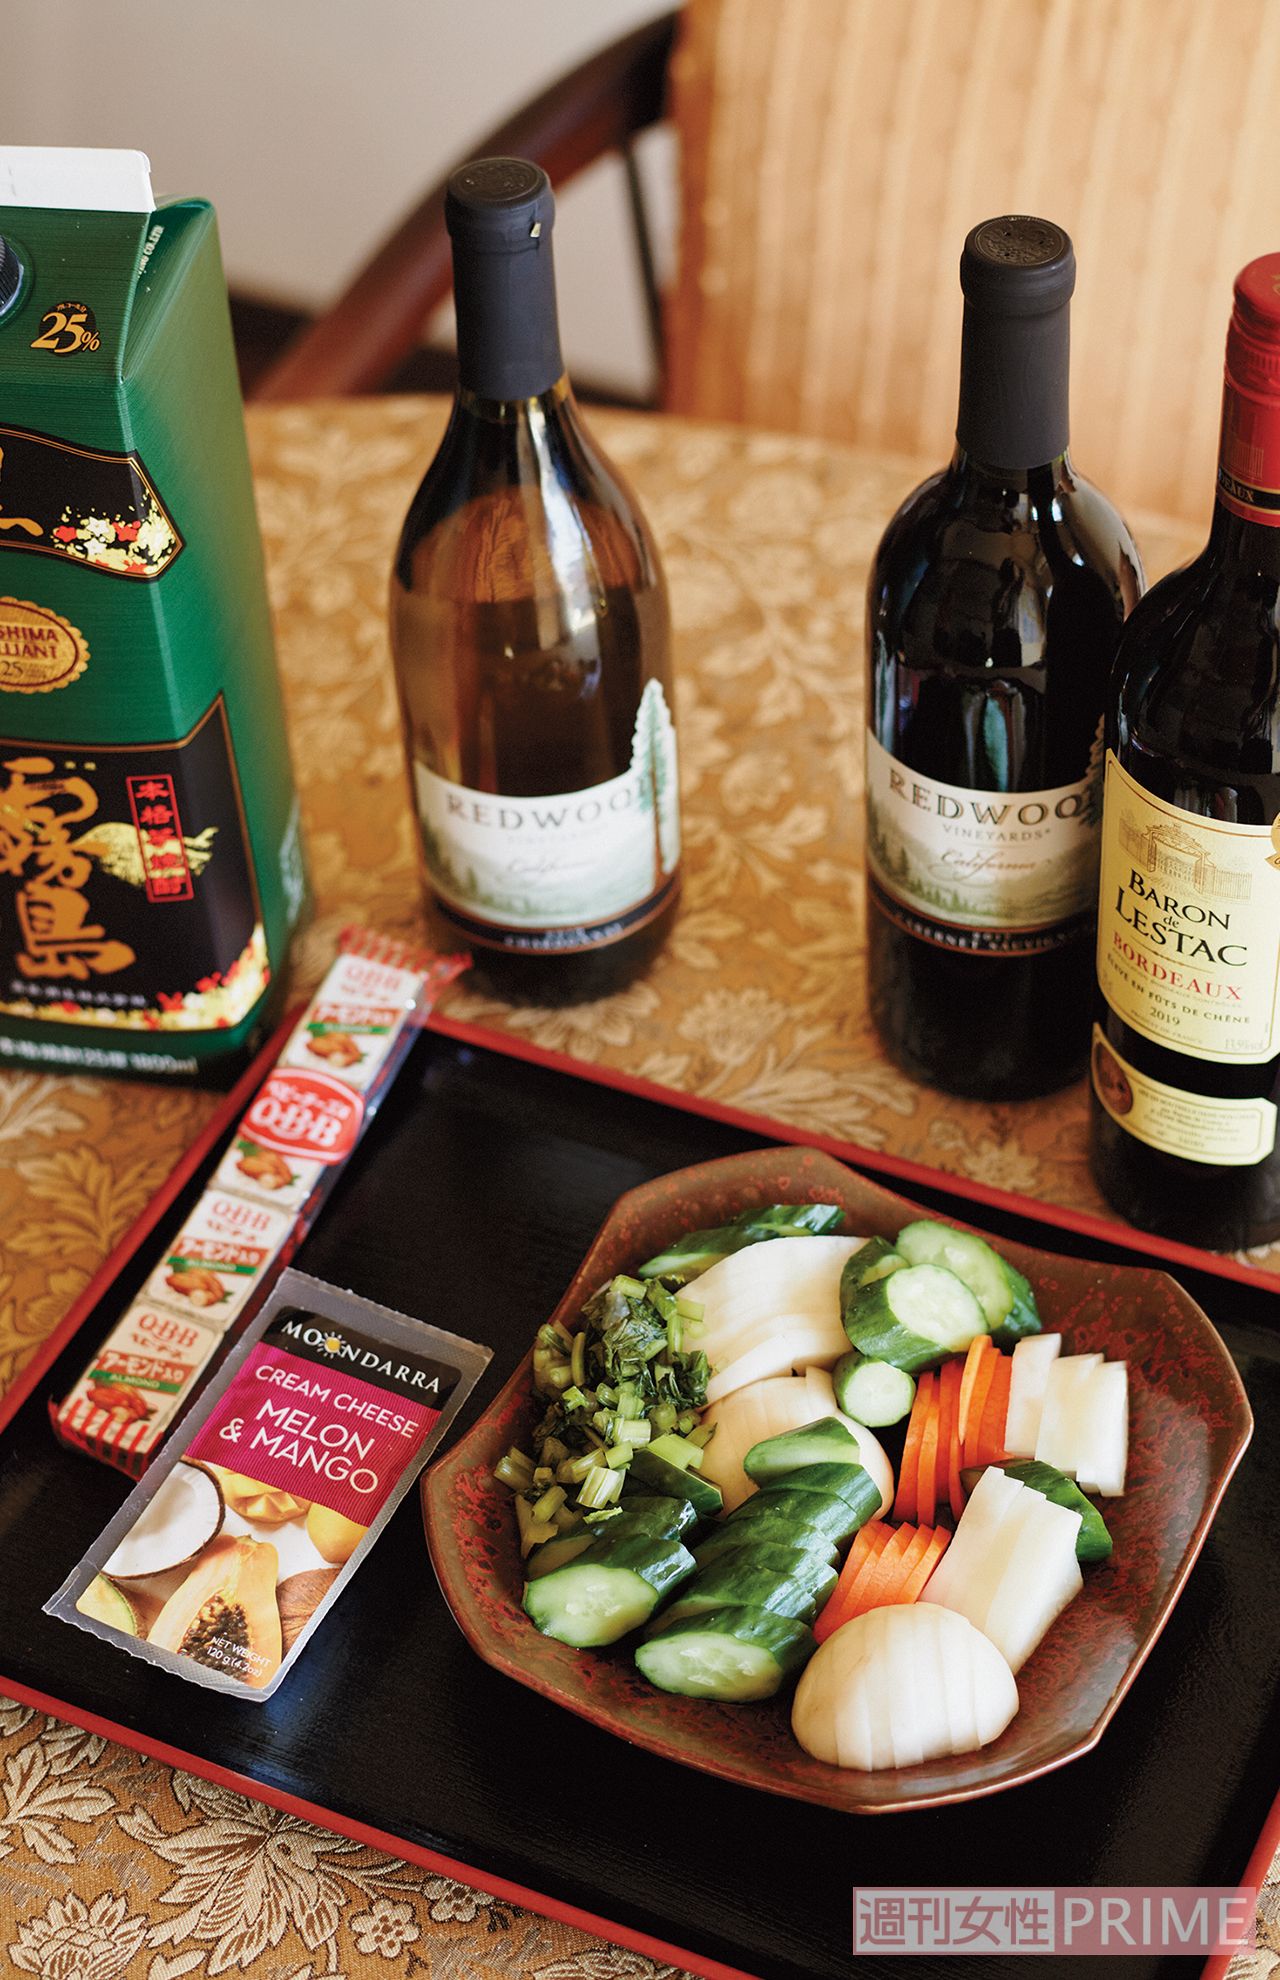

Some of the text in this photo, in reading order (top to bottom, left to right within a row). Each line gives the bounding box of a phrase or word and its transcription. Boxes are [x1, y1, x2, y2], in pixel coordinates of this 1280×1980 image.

[30, 311, 101, 354] 25%
[0, 642, 58, 660] LIANT
[446, 778, 650, 831] REDWOO
[1115, 885, 1248, 967] LESTAC
[1128, 868, 1231, 930] BARON
[1163, 915, 1180, 929] de
[1113, 930, 1243, 1001] BORDEAUX
[1150, 1006, 1181, 1026] 2019
[255, 1364, 419, 1439] CREAM CHEESE
[255, 1398, 376, 1461] MELON
[219, 1417, 379, 1494] & MANGO
[211, 1636, 272, 1668] NET WEIGHT
